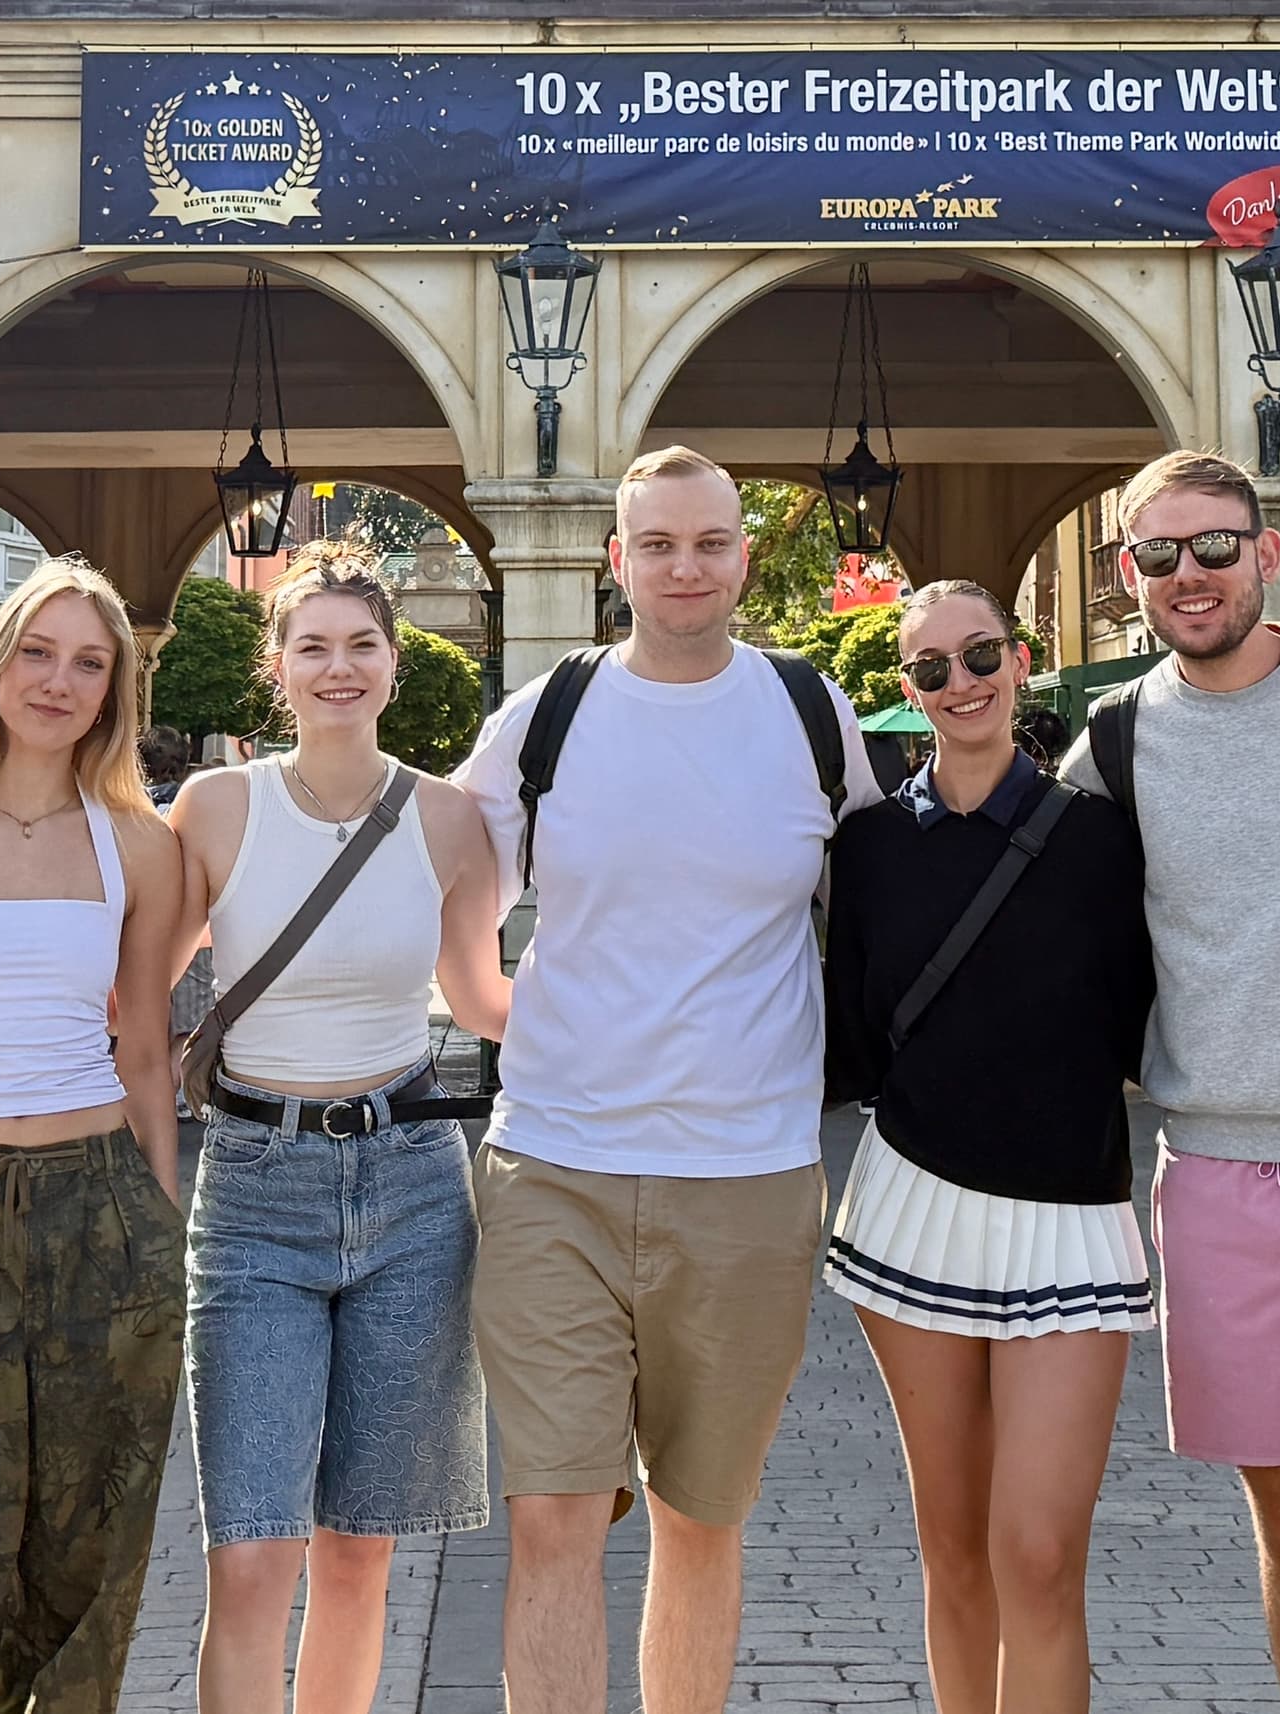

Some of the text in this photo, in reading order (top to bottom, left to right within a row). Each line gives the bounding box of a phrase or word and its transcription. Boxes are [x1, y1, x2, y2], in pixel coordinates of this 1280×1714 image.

[516, 72, 567, 115] 10
[575, 81, 602, 115] x
[804, 68, 1073, 122] Freizeitpark
[1087, 69, 1162, 113] der
[183, 119, 283, 137] 10x GOLDEN
[172, 143, 293, 161] TICKET AWARD
[517, 134, 541, 154] 10
[664, 137, 709, 157] parc
[716, 133, 740, 153] de
[746, 132, 808, 153] loisirs
[814, 132, 839, 152] du
[947, 132, 971, 151] 10
[1054, 131, 1123, 152] Theme
[1130, 130, 1178, 151] Park
[233, 206, 256, 214] WELT
[820, 198, 998, 218] EUROPA PARK
